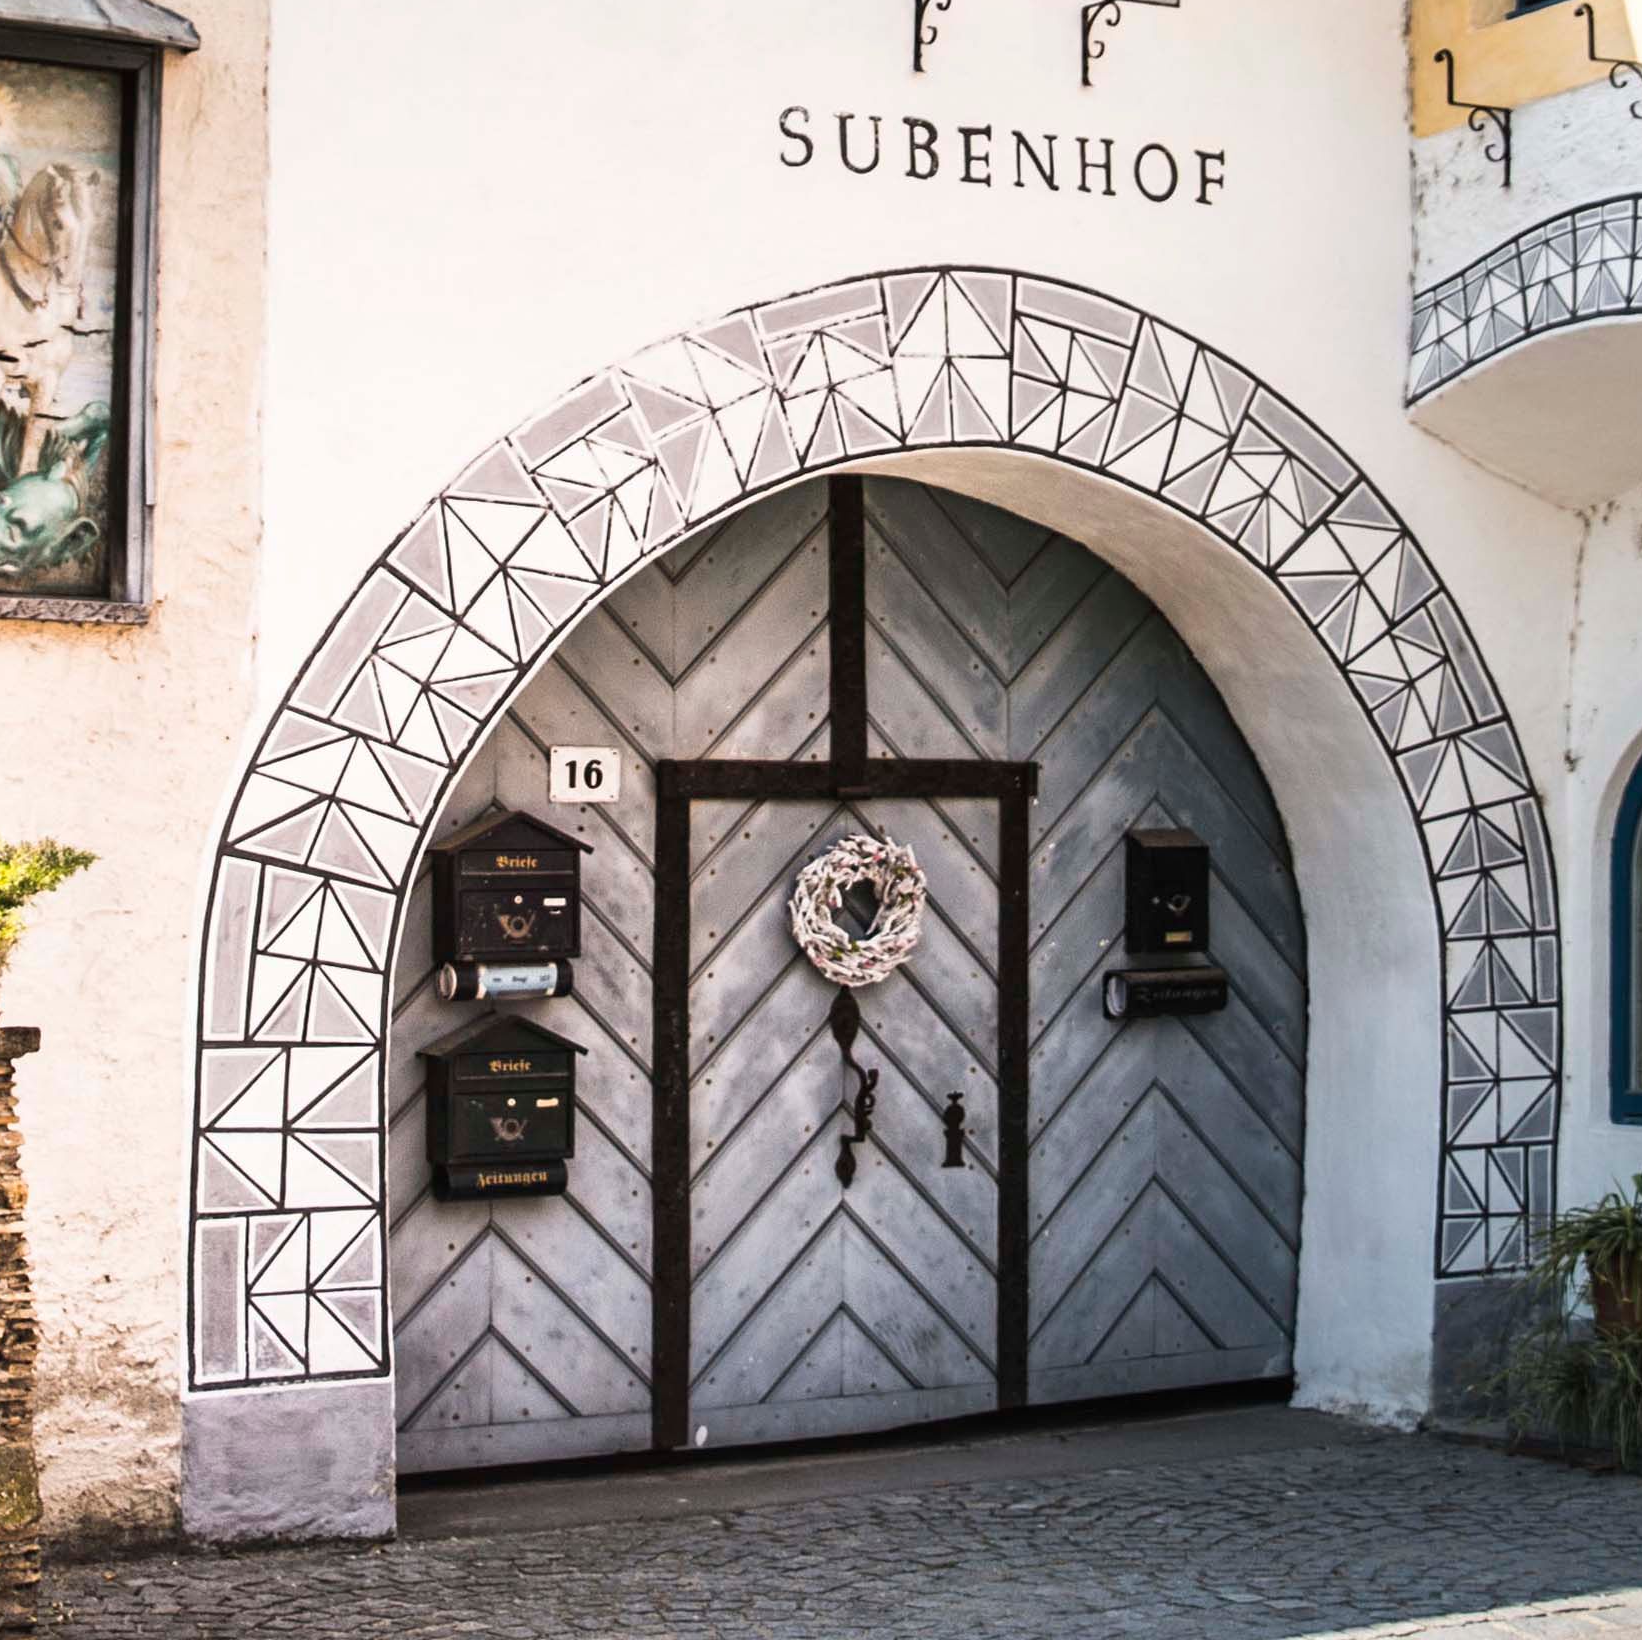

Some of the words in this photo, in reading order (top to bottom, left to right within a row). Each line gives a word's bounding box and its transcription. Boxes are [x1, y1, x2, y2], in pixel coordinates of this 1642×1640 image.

[778, 105, 1226, 205] SUBENHOF
[565, 759, 603, 789] 16
[495, 854, 539, 870] Briefe
[488, 1058, 532, 1073] Briefe
[476, 1170, 548, 1189] Zeitungen
